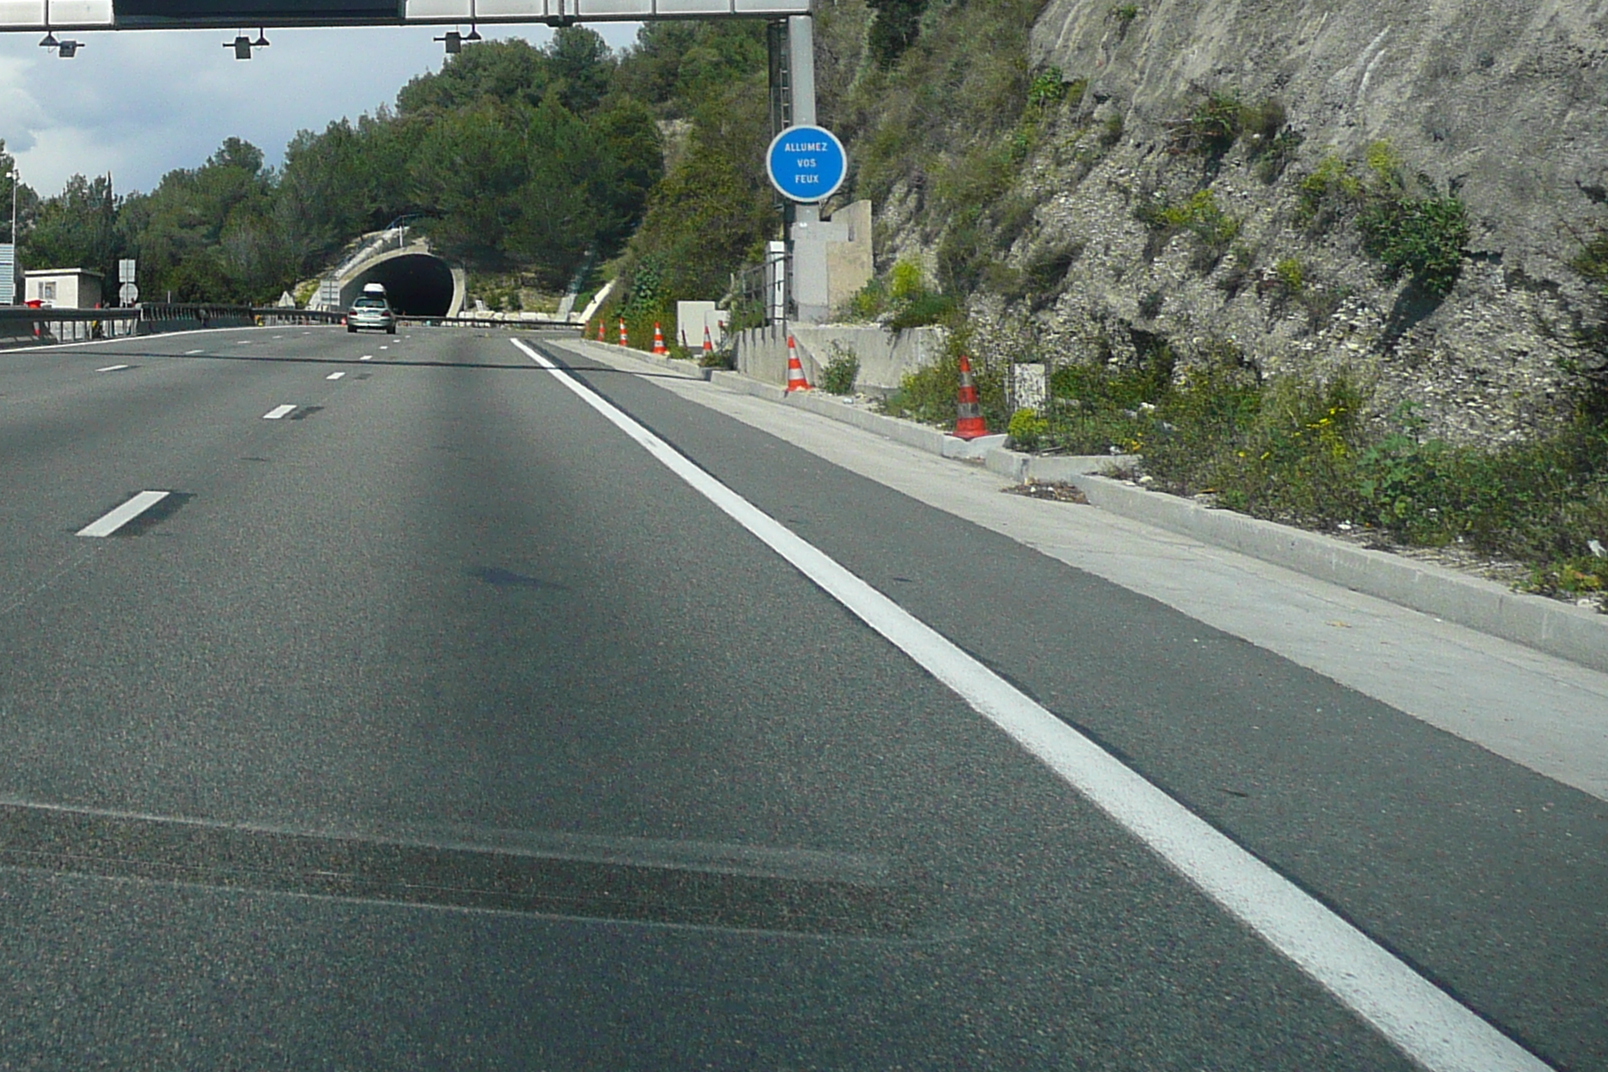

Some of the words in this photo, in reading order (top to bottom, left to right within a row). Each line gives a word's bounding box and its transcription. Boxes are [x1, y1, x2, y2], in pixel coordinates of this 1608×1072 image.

[785, 142, 828, 152] ALLUMEZ
[797, 158, 816, 168] VOS
[795, 174, 819, 184] FEUX
